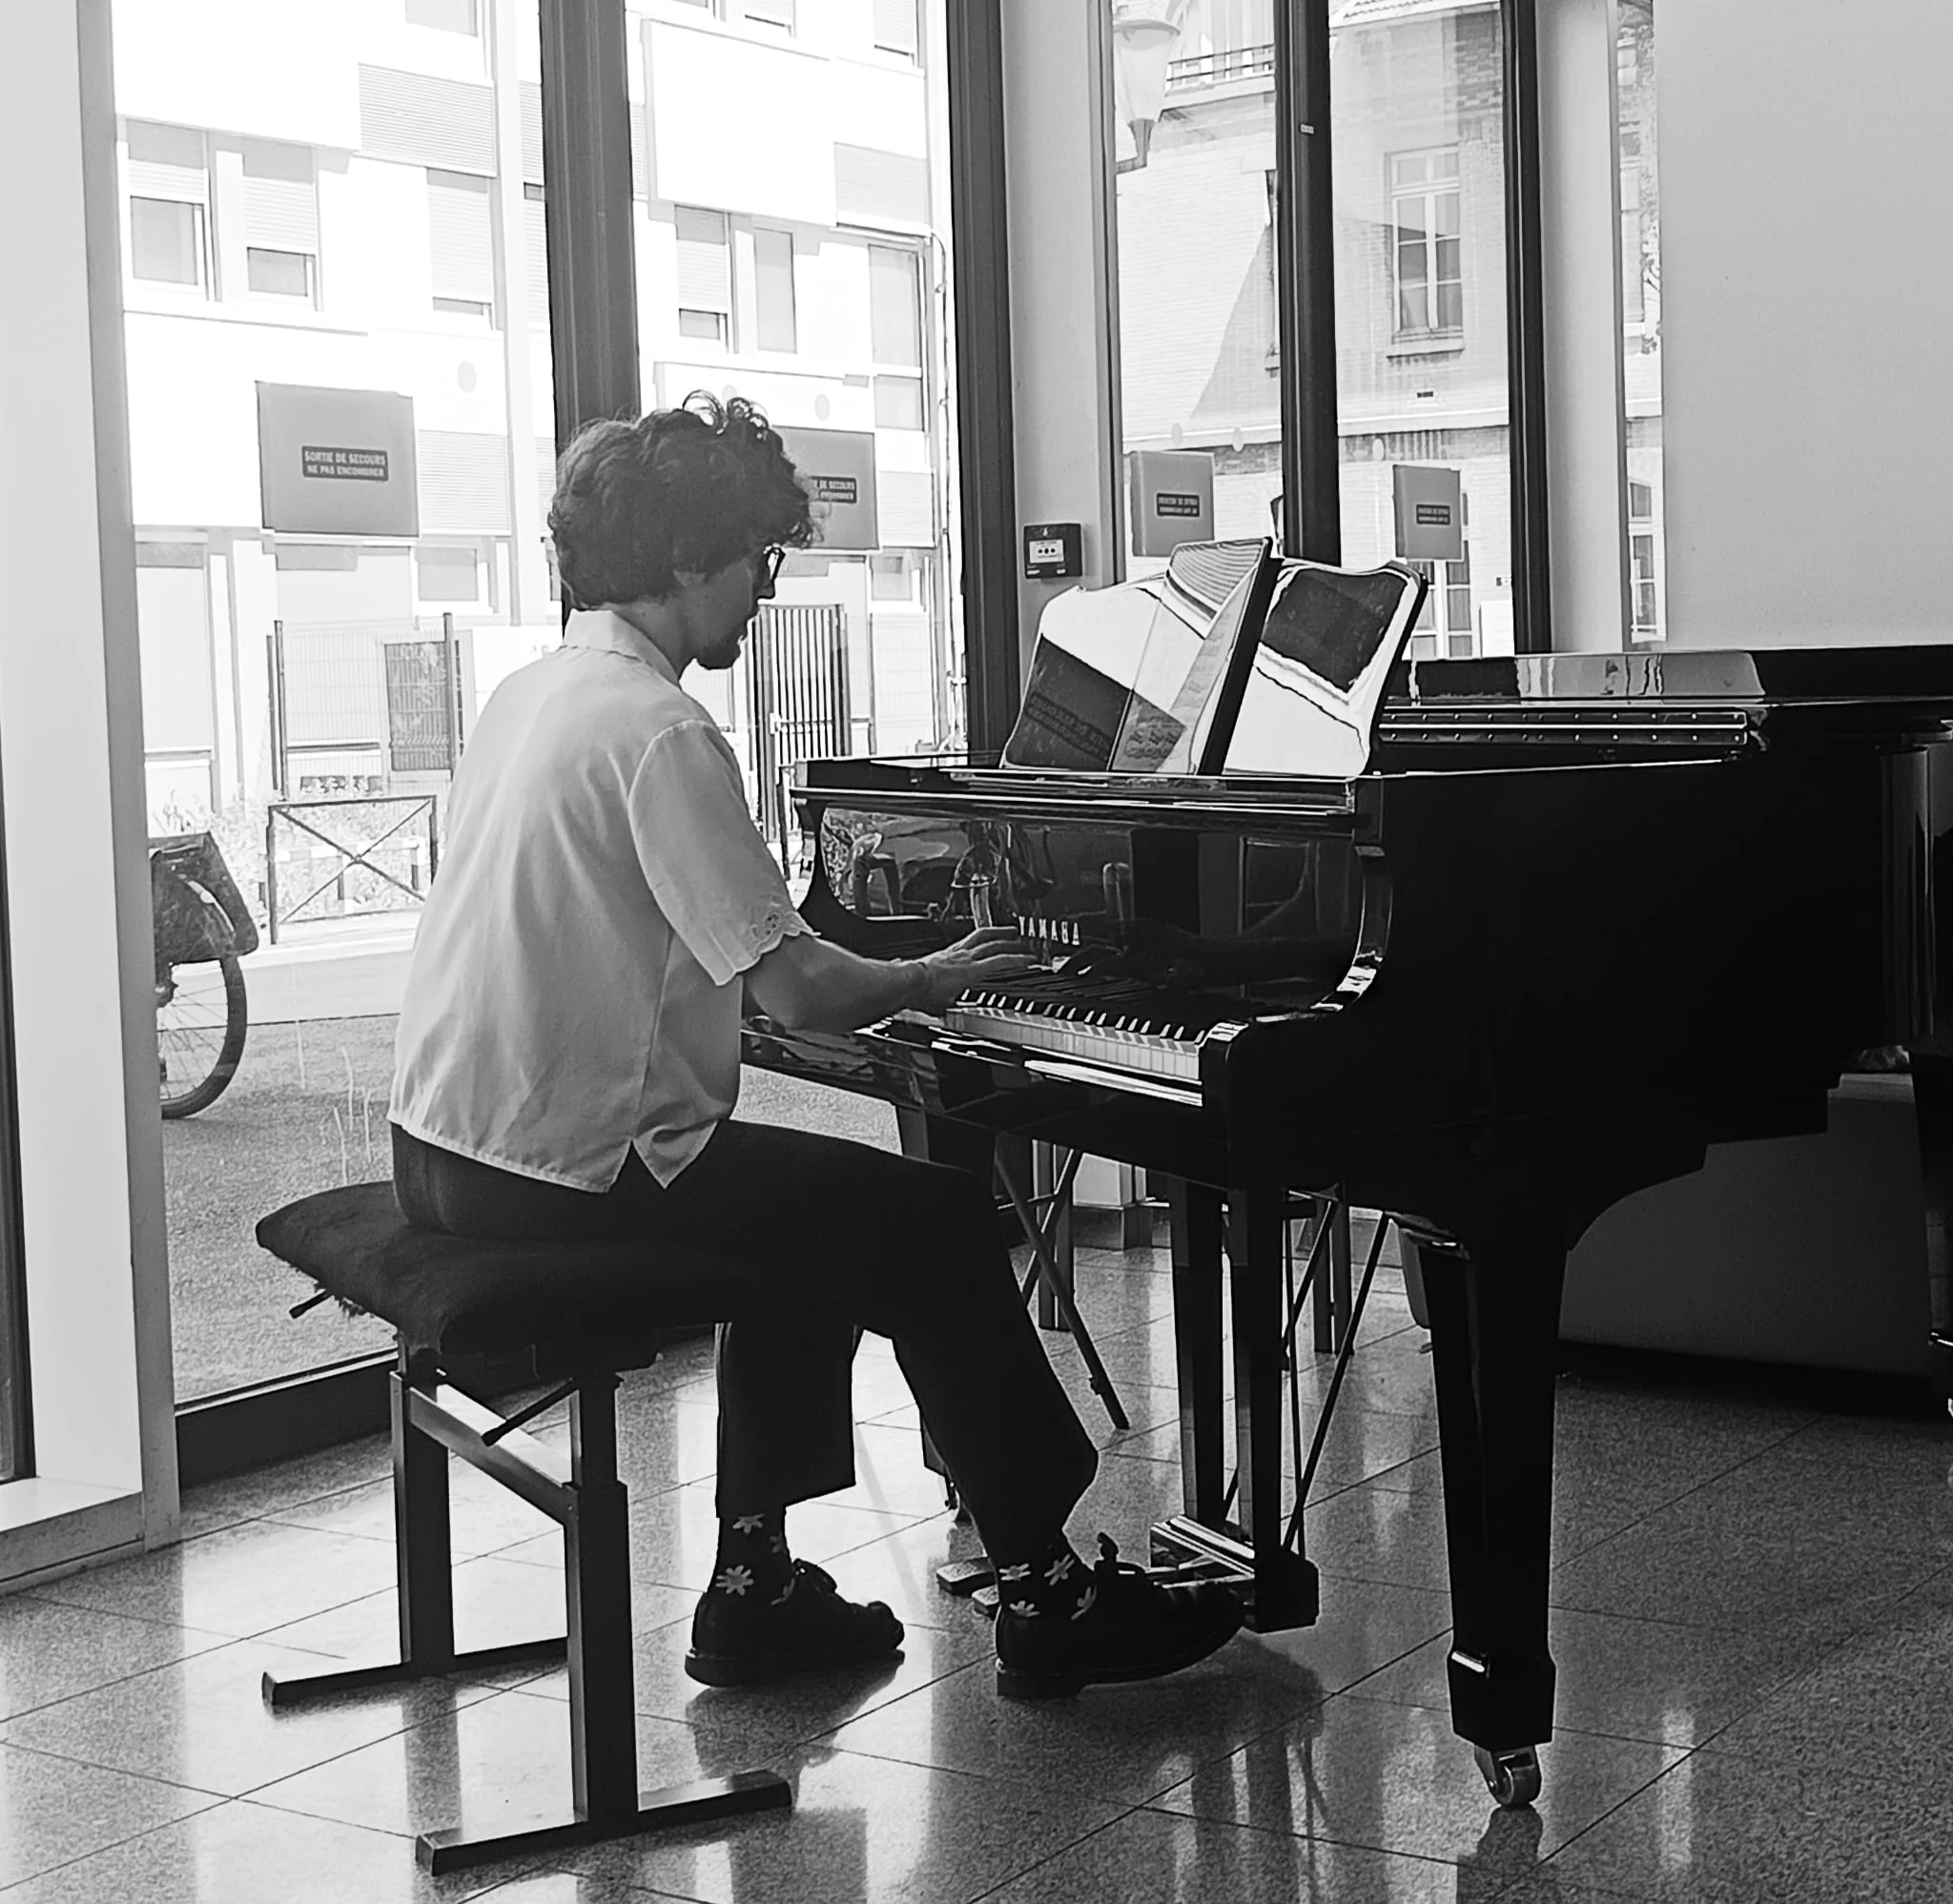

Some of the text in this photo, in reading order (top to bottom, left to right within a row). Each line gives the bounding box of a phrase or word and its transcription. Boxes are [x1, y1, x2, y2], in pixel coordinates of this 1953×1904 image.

[304, 451, 386, 464] SORTIE DE SECOURS
[319, 465, 335, 475] PAS
